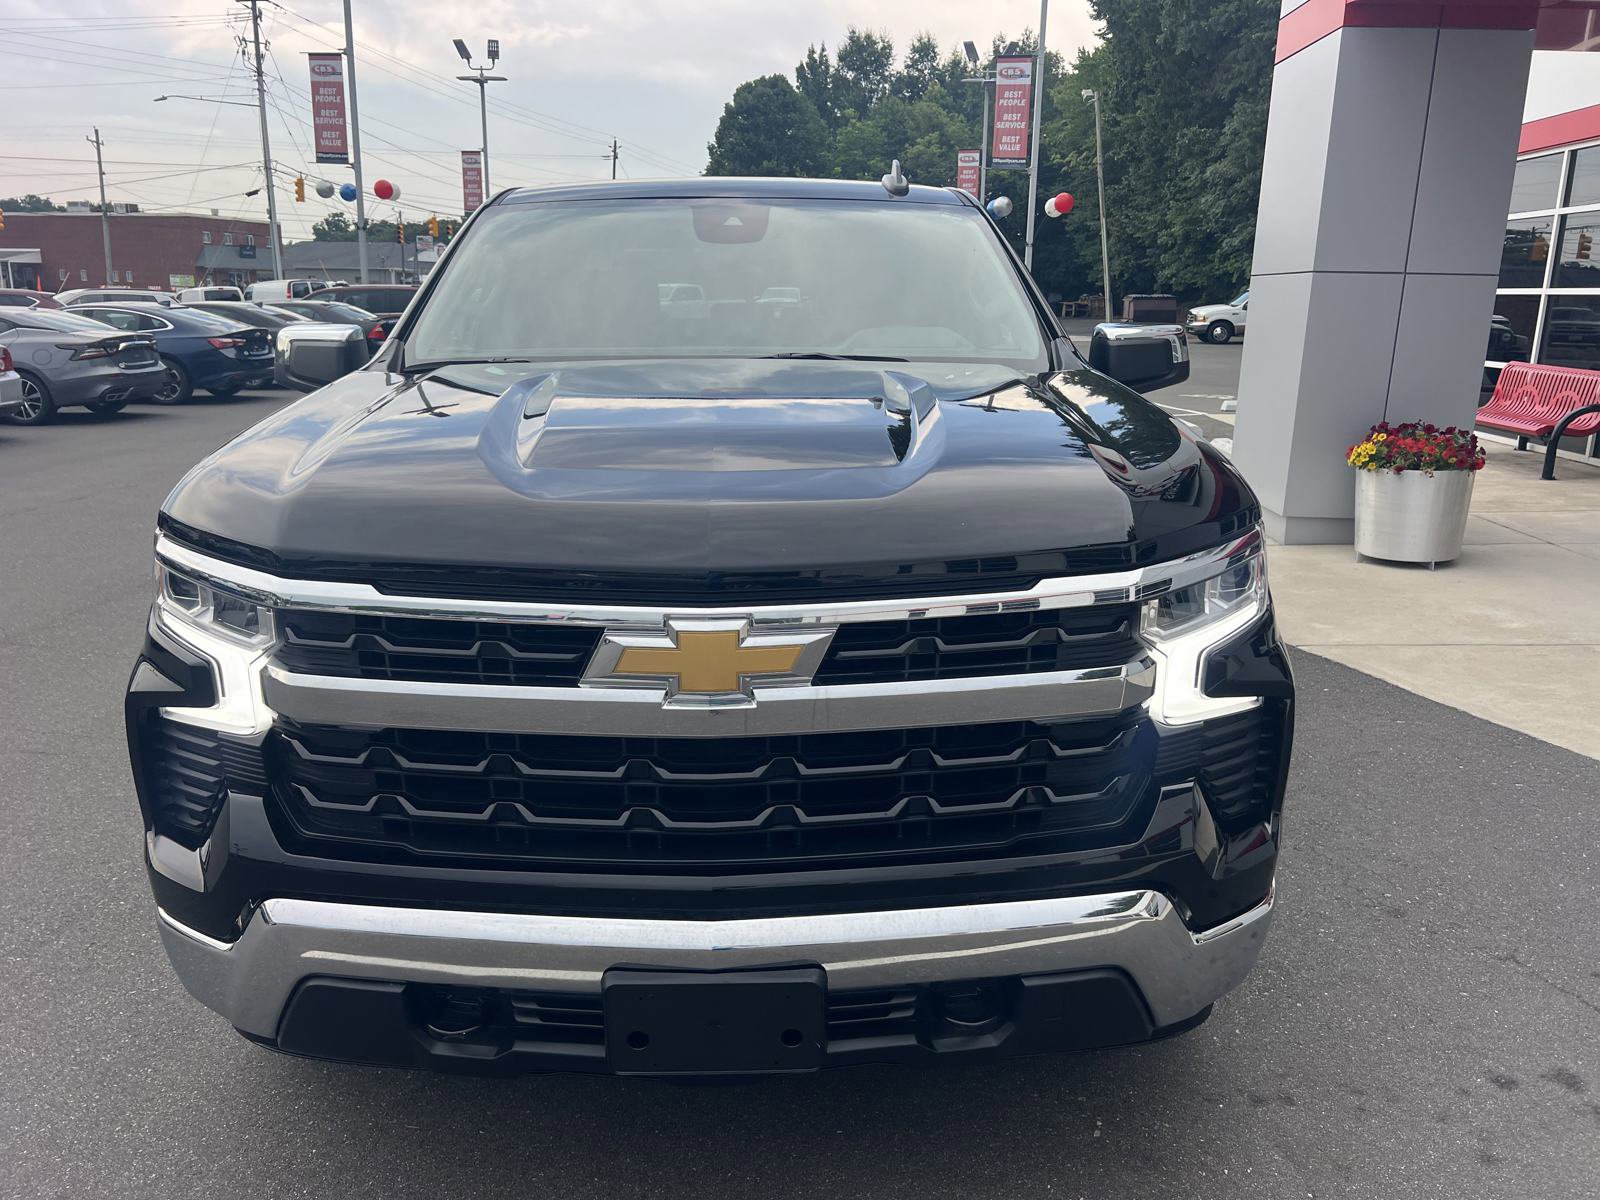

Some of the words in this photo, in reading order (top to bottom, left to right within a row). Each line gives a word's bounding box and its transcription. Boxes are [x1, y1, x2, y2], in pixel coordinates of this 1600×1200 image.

[319, 87, 337, 95] BEST
[1003, 90, 1023, 98] BEST
[315, 95, 341, 103] PEOPLE
[999, 98, 1027, 106] PEOPLE
[320, 109, 338, 117] BEST
[1002, 113, 1022, 121] BEST
[315, 117, 345, 125] SERVICE
[996, 121, 1026, 129] SERVICE
[320, 138, 342, 146] VALUE
[1001, 135, 1020, 143] BEST
[999, 143, 1022, 151] VALUE
